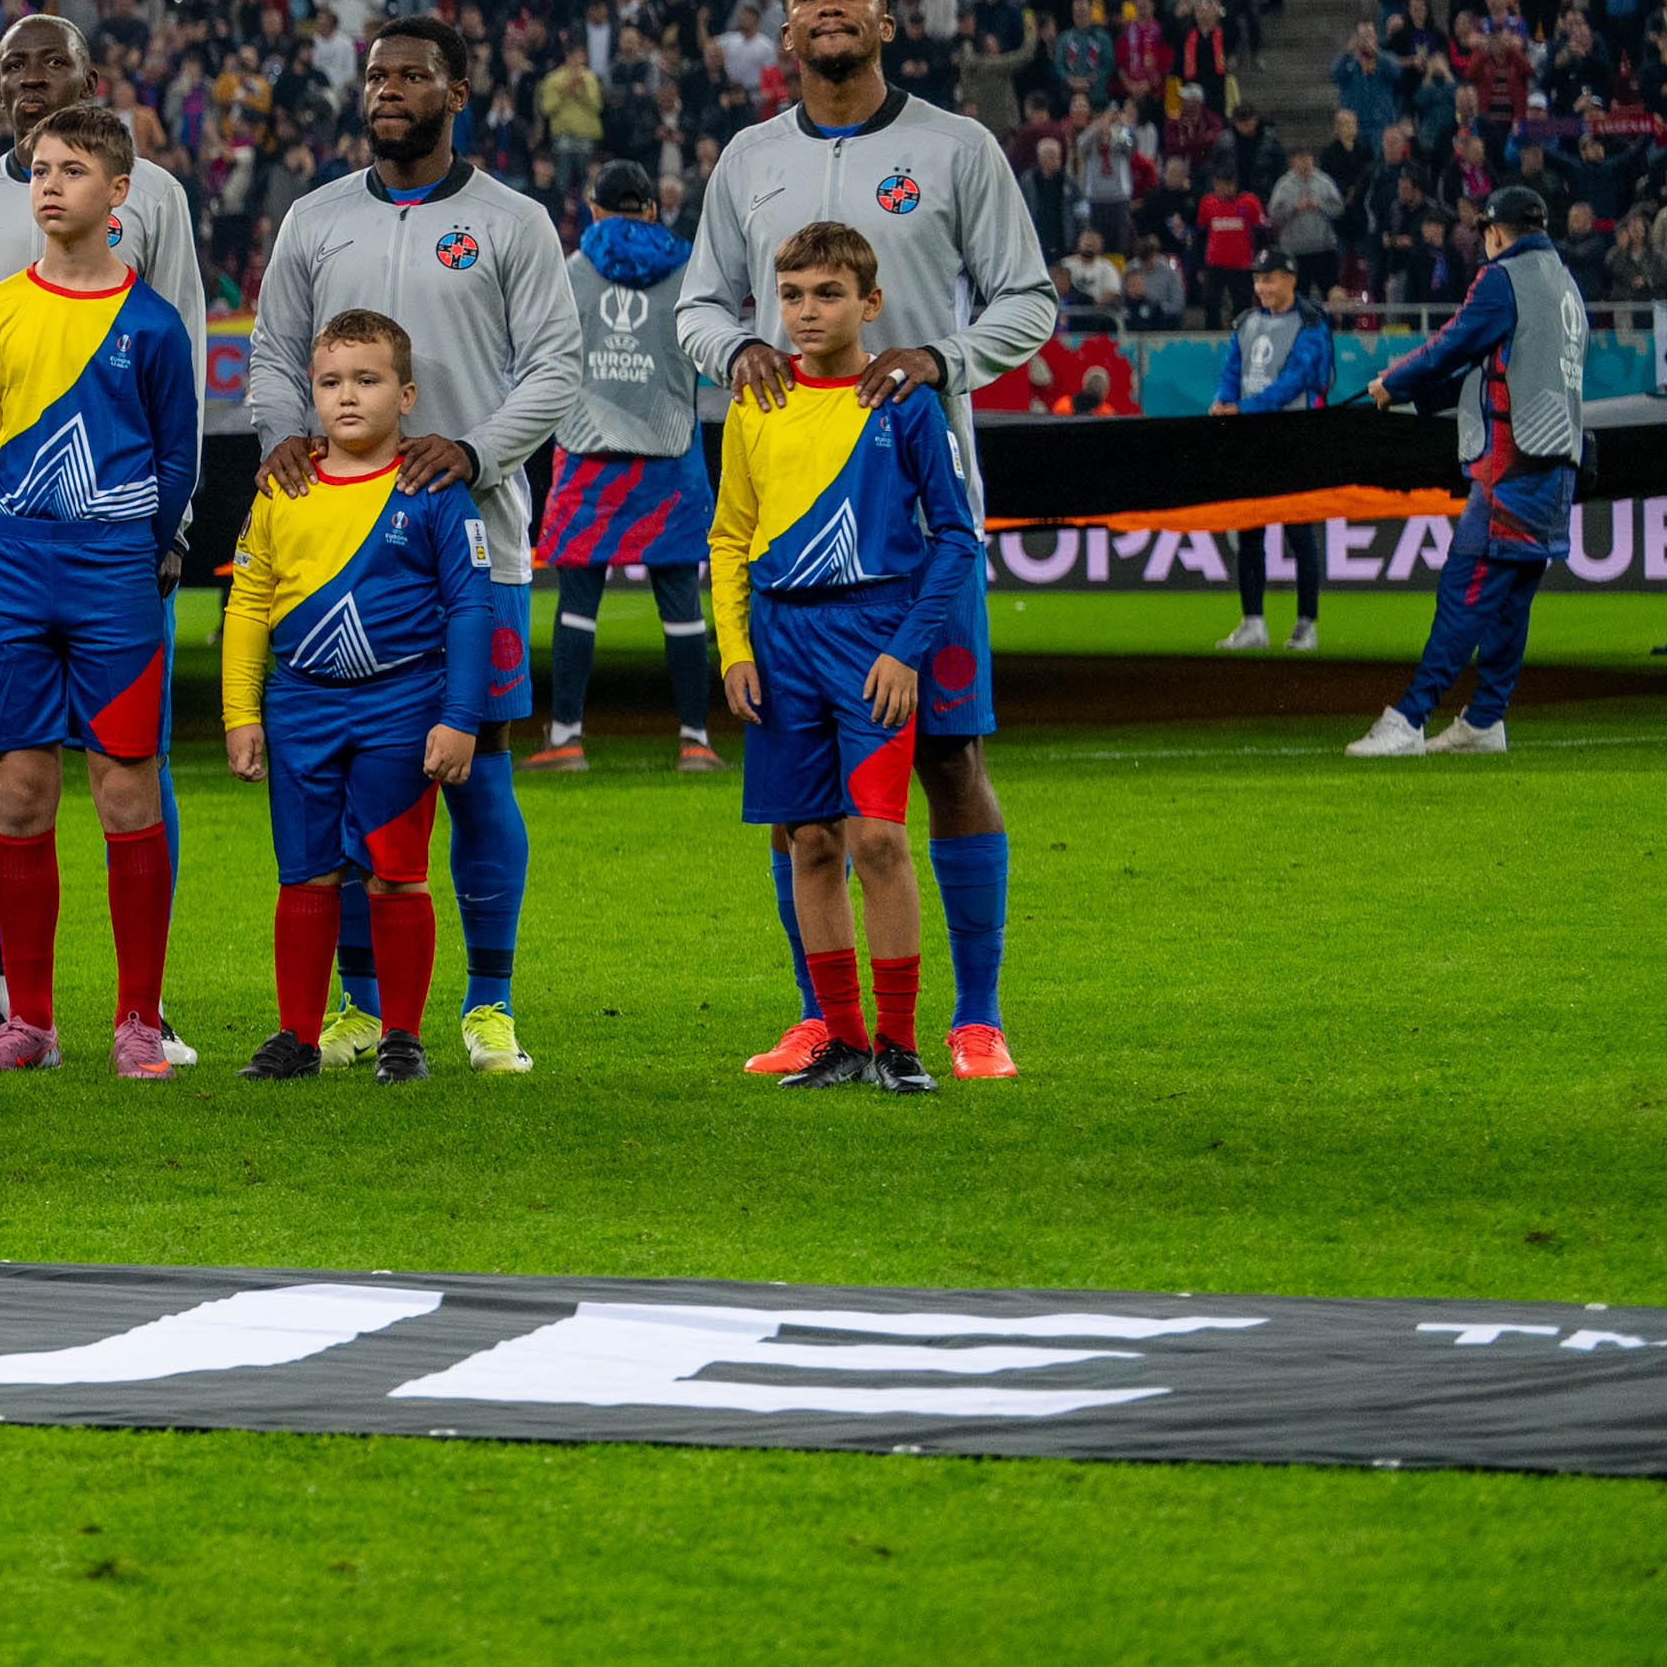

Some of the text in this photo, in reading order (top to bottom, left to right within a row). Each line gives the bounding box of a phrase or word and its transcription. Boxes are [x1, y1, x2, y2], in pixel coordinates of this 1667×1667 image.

[588, 351, 655, 371] EUROPA
[593, 367, 649, 383] LEAGUE
[985, 527, 1228, 583] OPA
